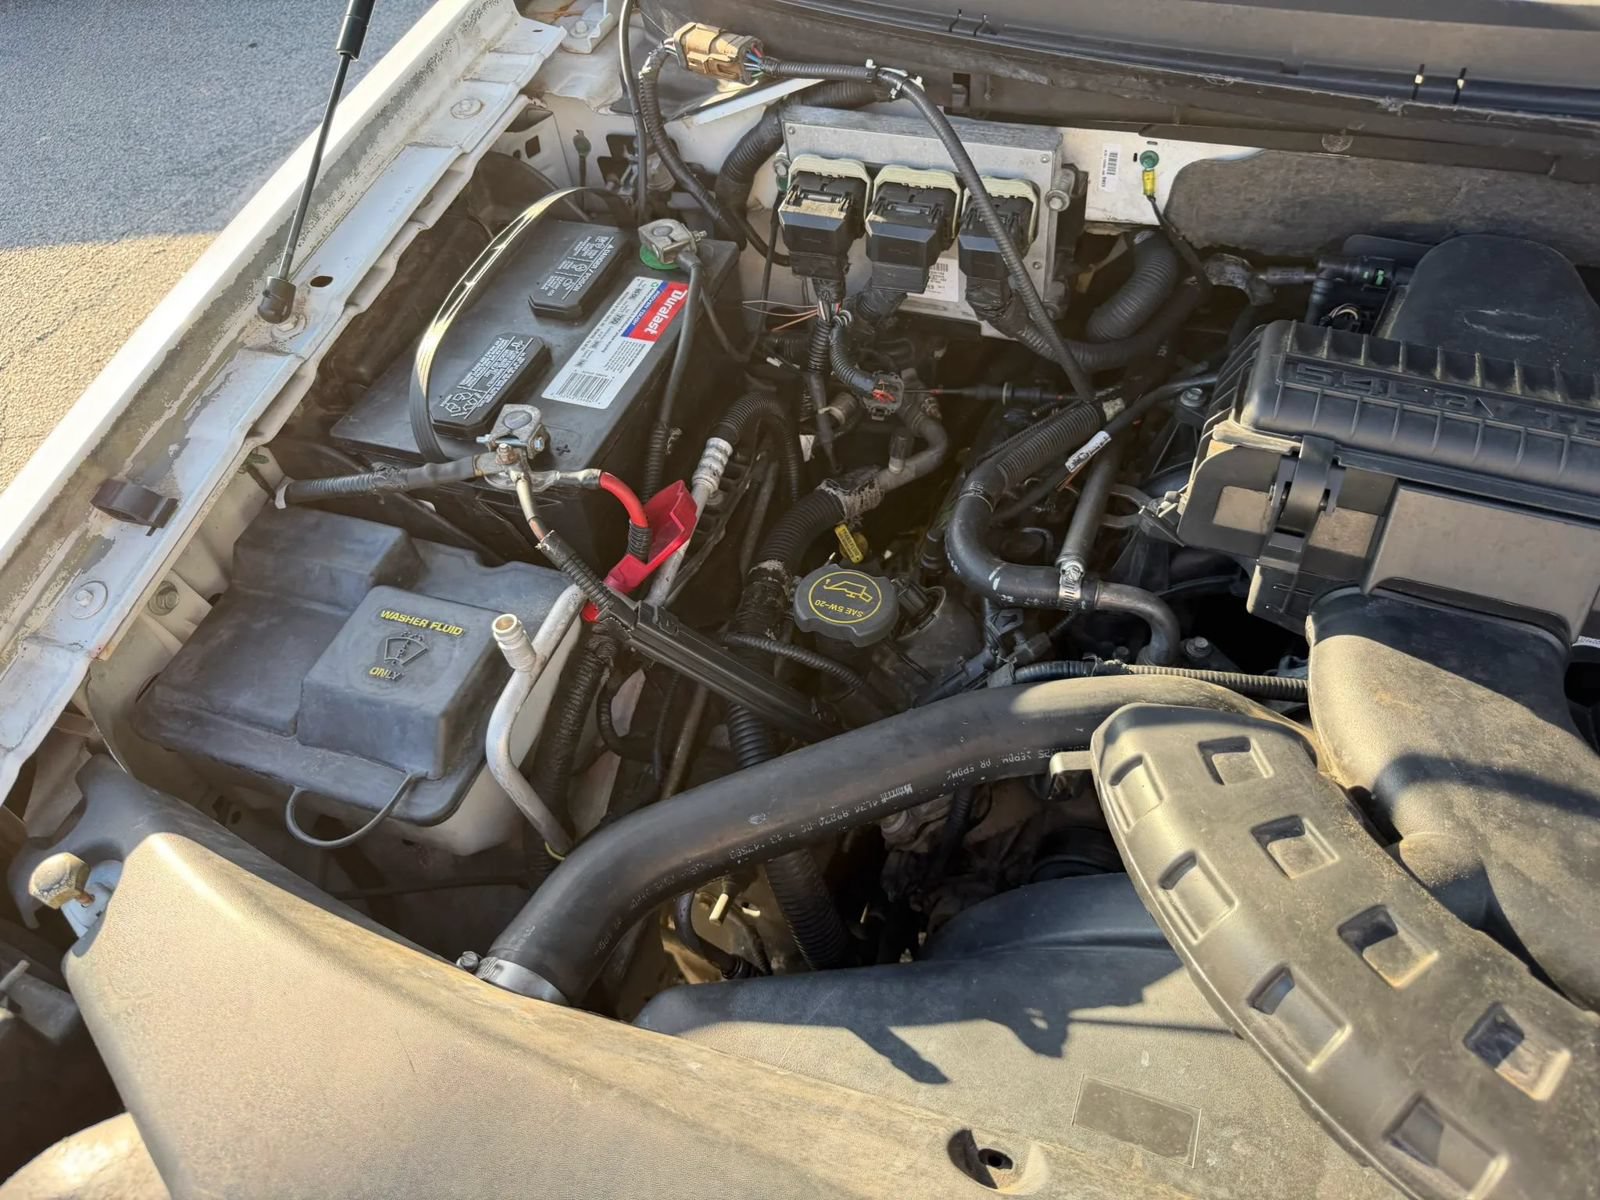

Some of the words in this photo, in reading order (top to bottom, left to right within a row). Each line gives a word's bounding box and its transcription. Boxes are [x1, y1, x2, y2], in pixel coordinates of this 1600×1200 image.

[644, 289, 688, 335] Duralast
[814, 599, 844, 613] 5W-20
[845, 607, 864, 618] SAE
[380, 610, 429, 628] WASHER
[429, 622, 464, 638] FLUID
[368, 666, 401, 680] ONLY
